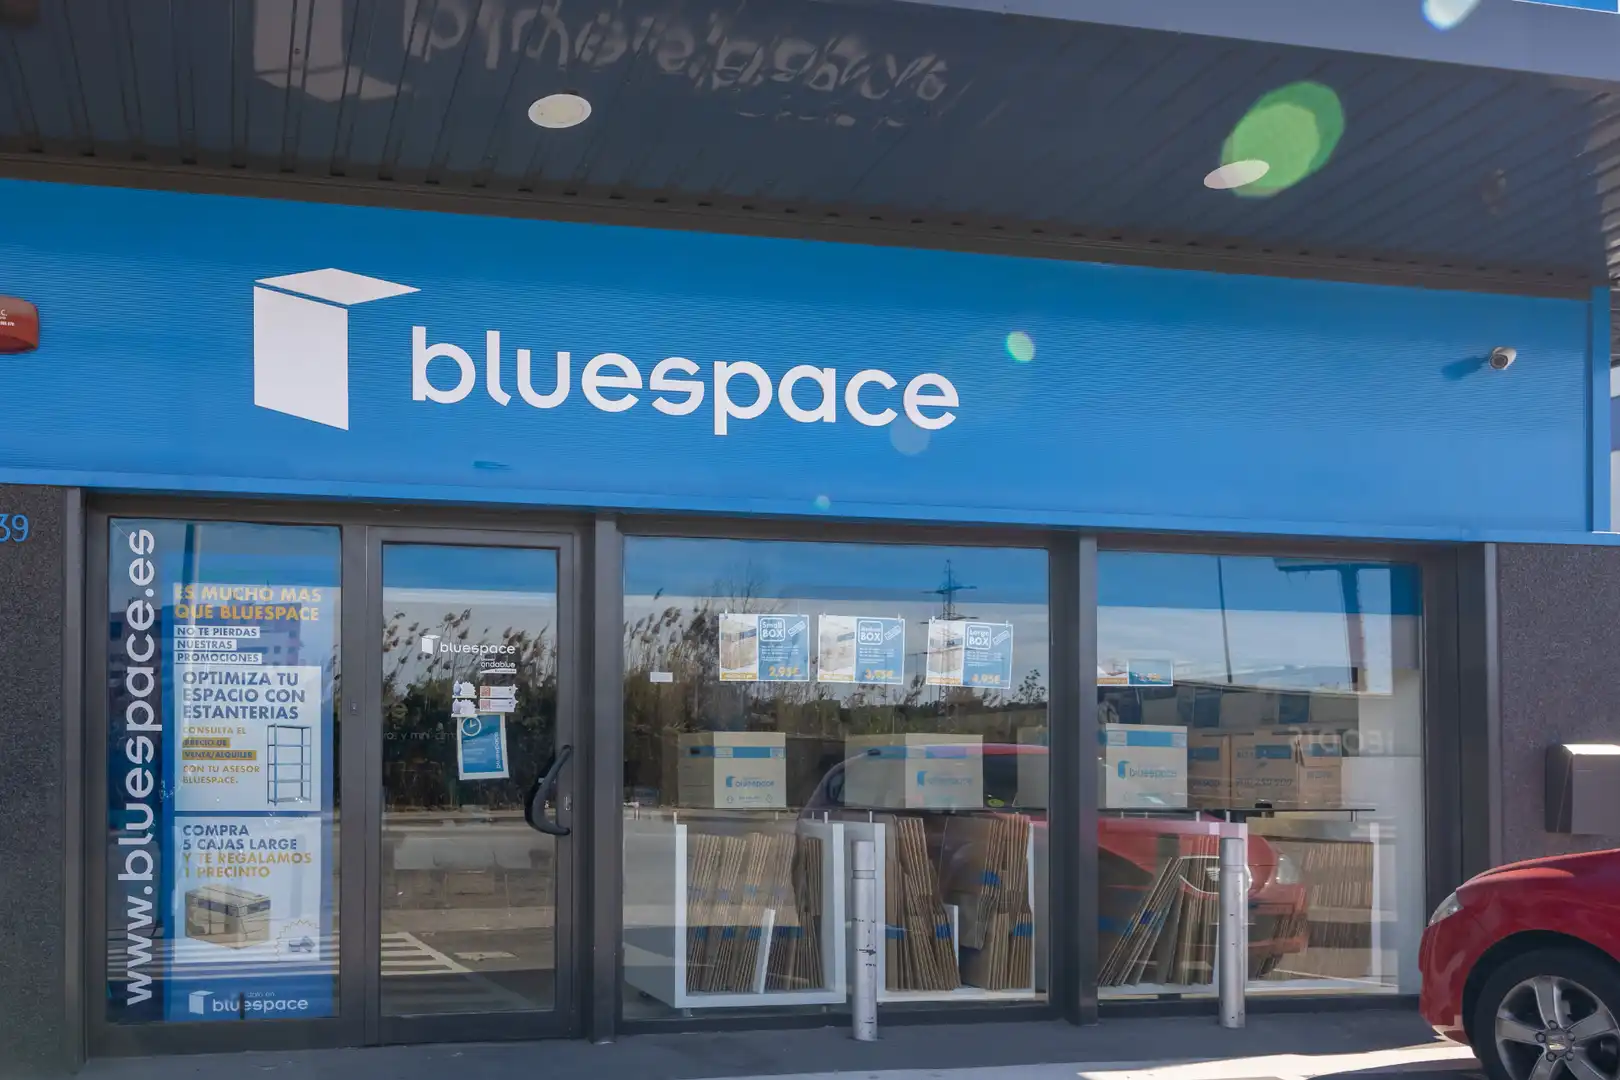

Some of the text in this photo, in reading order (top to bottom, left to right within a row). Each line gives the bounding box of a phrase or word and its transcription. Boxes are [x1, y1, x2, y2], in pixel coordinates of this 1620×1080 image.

[412, 325, 959, 436] bluespace
[201, 585, 274, 601] MUCHO
[280, 587, 322, 602] MAS
[175, 604, 319, 621] QUE BLUESPACE
[177, 627, 257, 637] NO TE PIERDAS
[762, 629, 783, 638] BOX
[861, 632, 880, 641] BOX
[177, 640, 233, 649] NUESTRAS
[969, 636, 989, 646] BOX
[440, 642, 516, 656] bluespace
[177, 652, 259, 663] PROMOCIONES
[183, 671, 299, 687] OPTIMIZA TU
[183, 688, 306, 704] ESPACIO CON
[183, 705, 299, 720] ESTANTERIAS
[183, 726, 247, 735] CONSULTA EL
[184, 750, 253, 760] VENTA/ALQUILER
[117, 529, 162, 1006] www.bluespace.es
[183, 765, 260, 774] CON TU ASESOR
[183, 824, 250, 837] COMPRA
[183, 838, 297, 851] 5 CAJAS LARGE
[183, 852, 312, 865] Y TE REGALAMOS
[197, 866, 271, 879] PRECINTO
[212, 998, 309, 1014] bluespace
